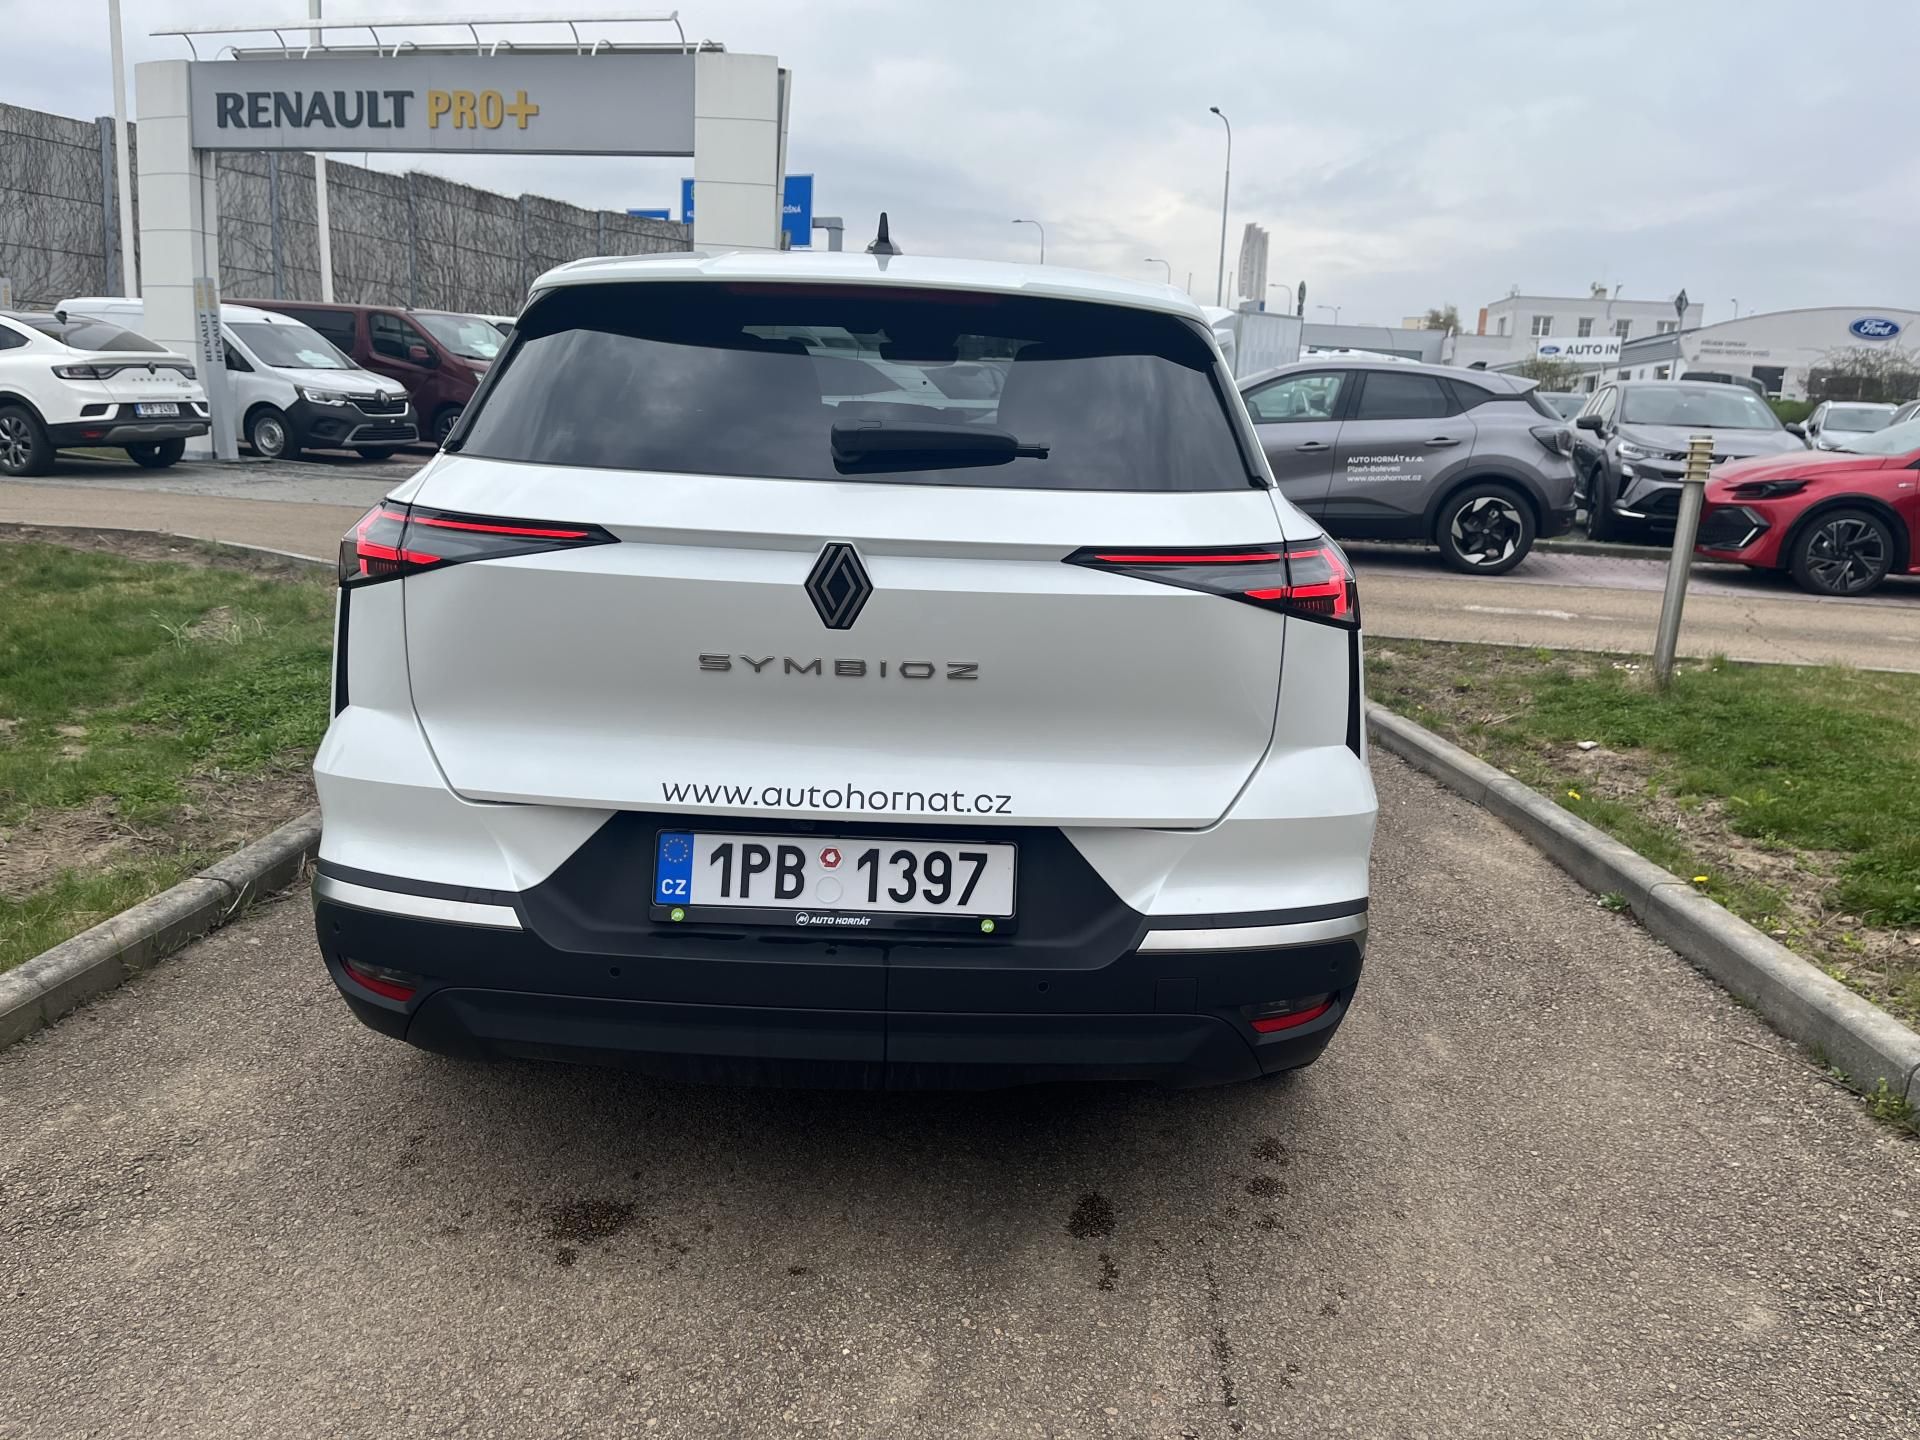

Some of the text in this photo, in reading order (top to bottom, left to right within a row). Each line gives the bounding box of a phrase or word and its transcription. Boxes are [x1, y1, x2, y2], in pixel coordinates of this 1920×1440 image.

[215, 90, 539, 129] RENAULT PRO+
[200, 312, 212, 362] RENAULT
[210, 312, 223, 362] RENAULT
[1860, 320, 1893, 335] Ford
[1566, 344, 1602, 354] AUTO
[1605, 344, 1619, 354] IN
[1371, 454, 1405, 463] HORNÁT
[699, 653, 979, 680] SYMBIOZ
[662, 782, 1012, 814] www.autohornat.cz
[661, 878, 687, 896] CZ
[709, 843, 988, 906] 1PB 1397
[810, 916, 834, 924] AUTO
[835, 916, 871, 925] HORNÁT
